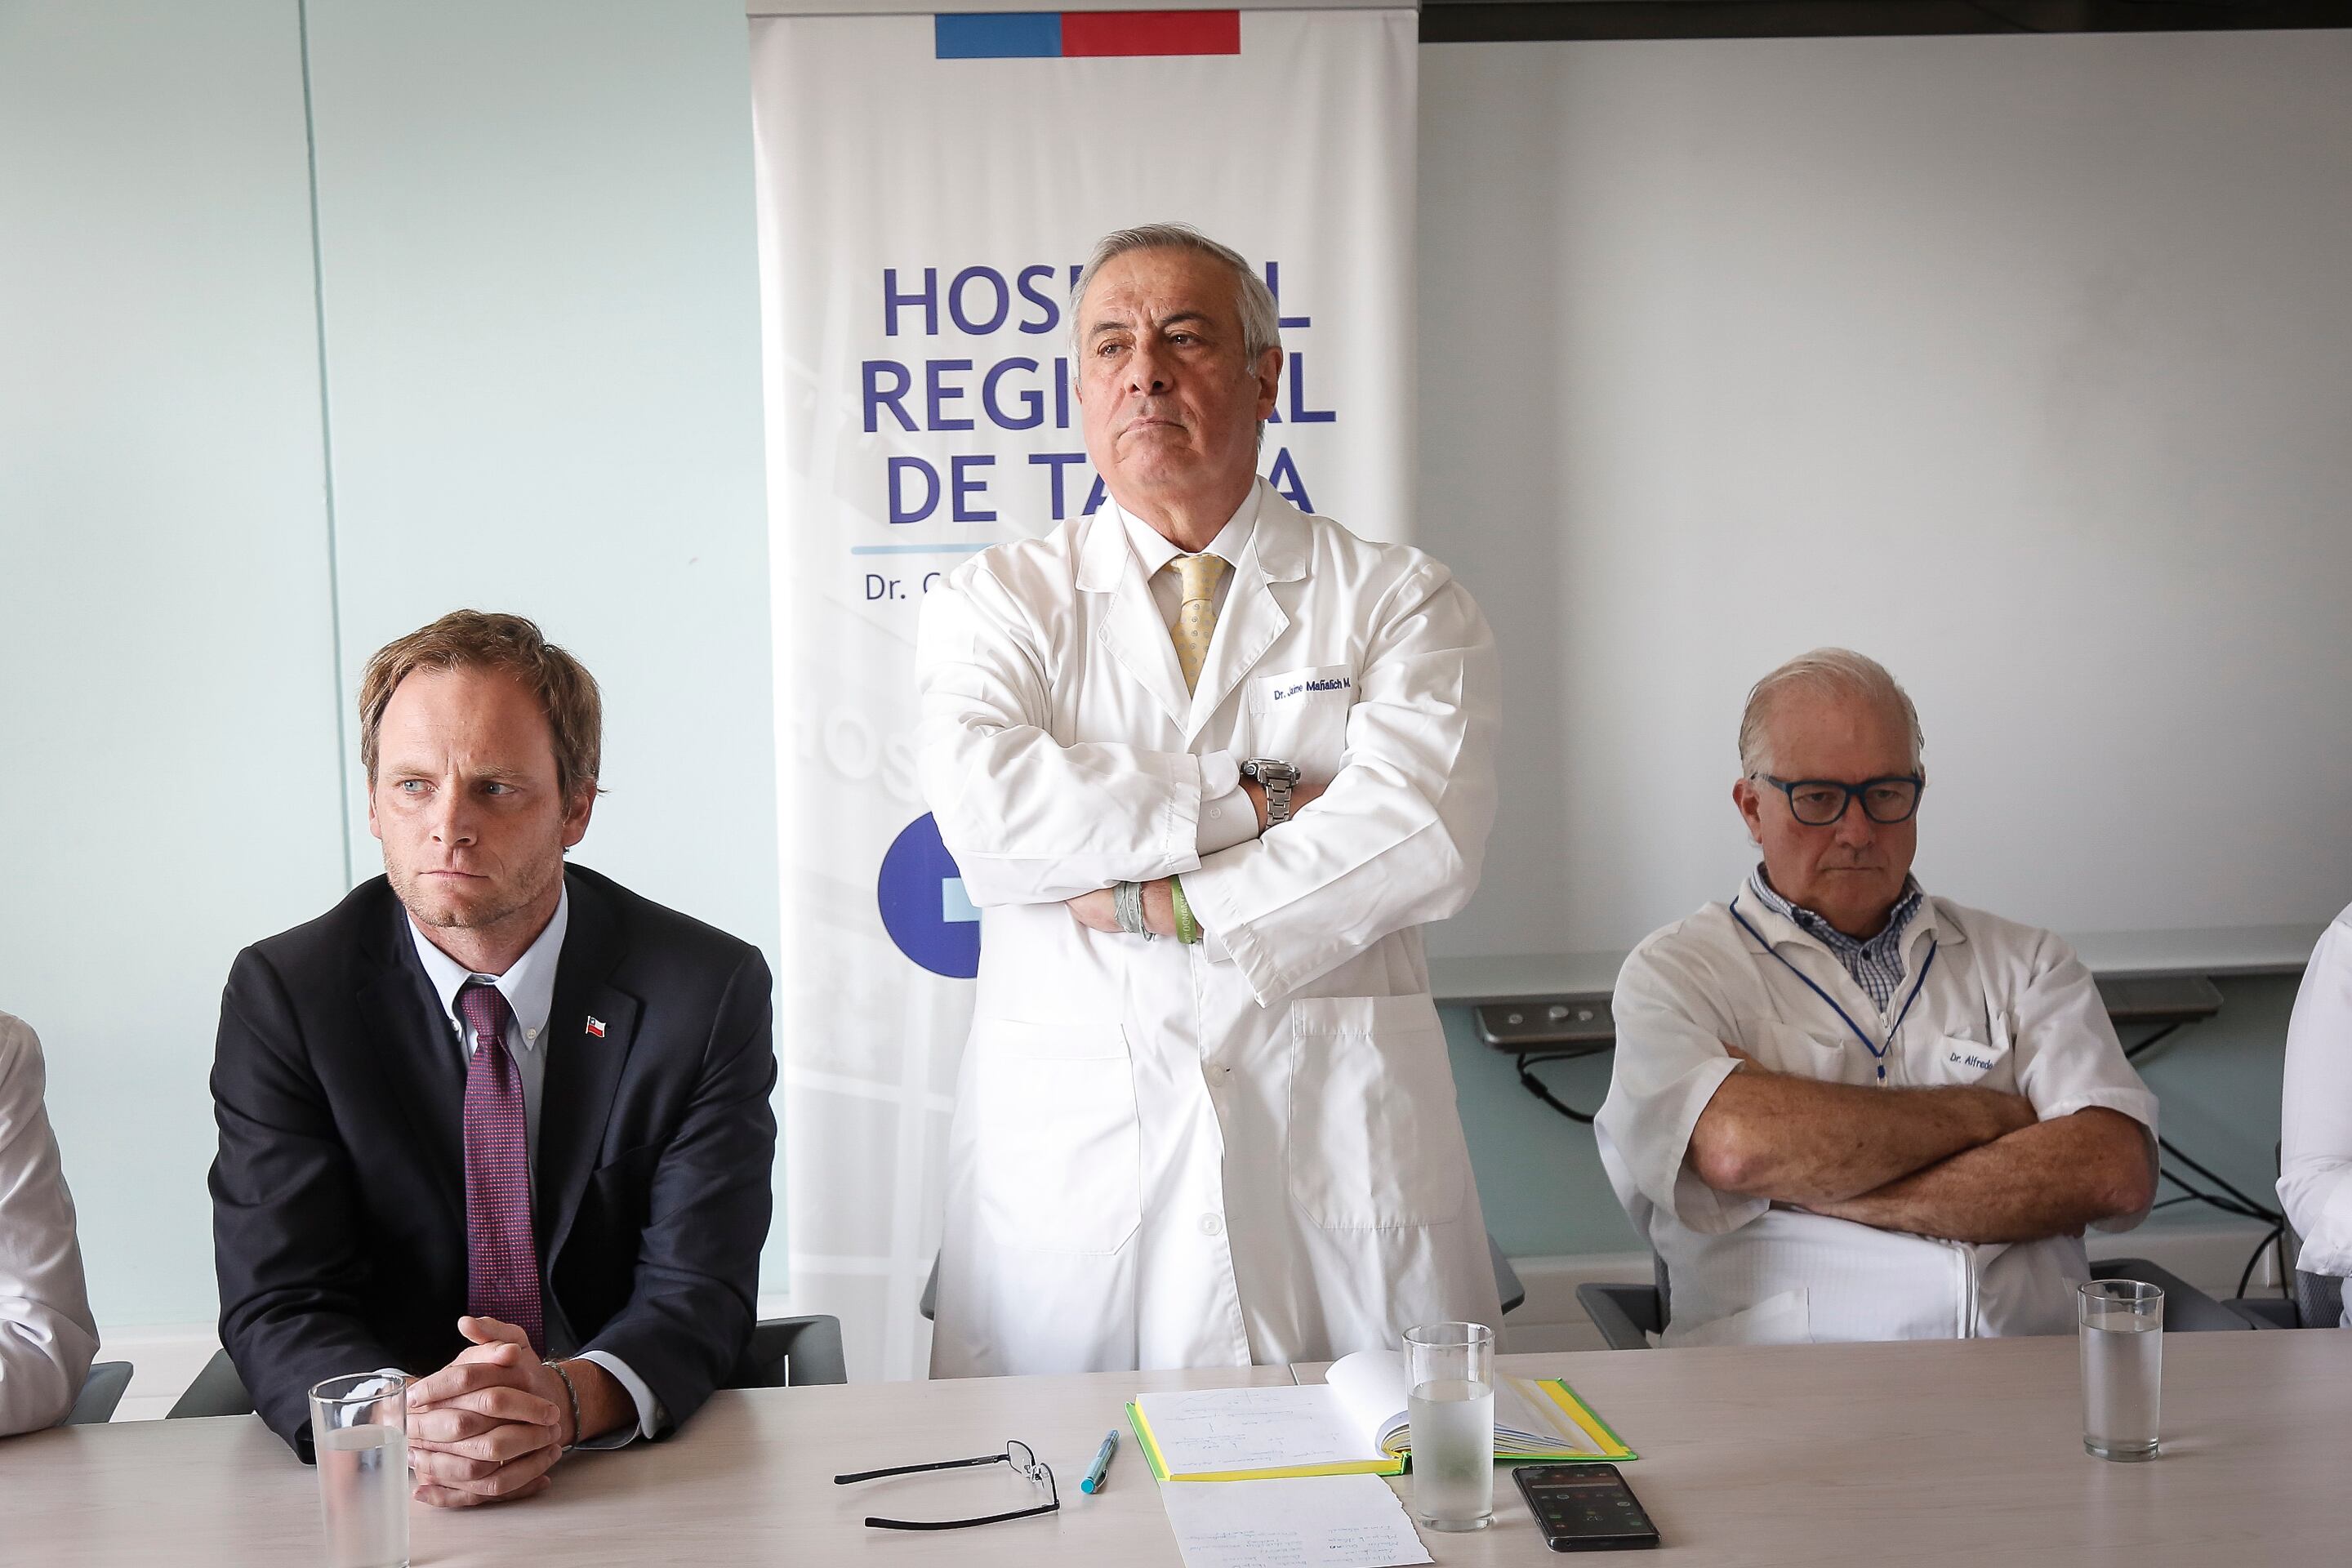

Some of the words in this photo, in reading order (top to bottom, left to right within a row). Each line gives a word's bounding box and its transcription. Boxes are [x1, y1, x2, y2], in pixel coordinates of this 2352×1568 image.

[884, 261, 1311, 336] HOSL
[862, 352, 1336, 433] REGIL
[889, 454, 997, 524] DE
[866, 573, 906, 600] Dr.
[1274, 690, 1285, 700] Dr.
[1950, 1053, 1961, 1063] Dr.
[1965, 1055, 1993, 1070] Alfredo
